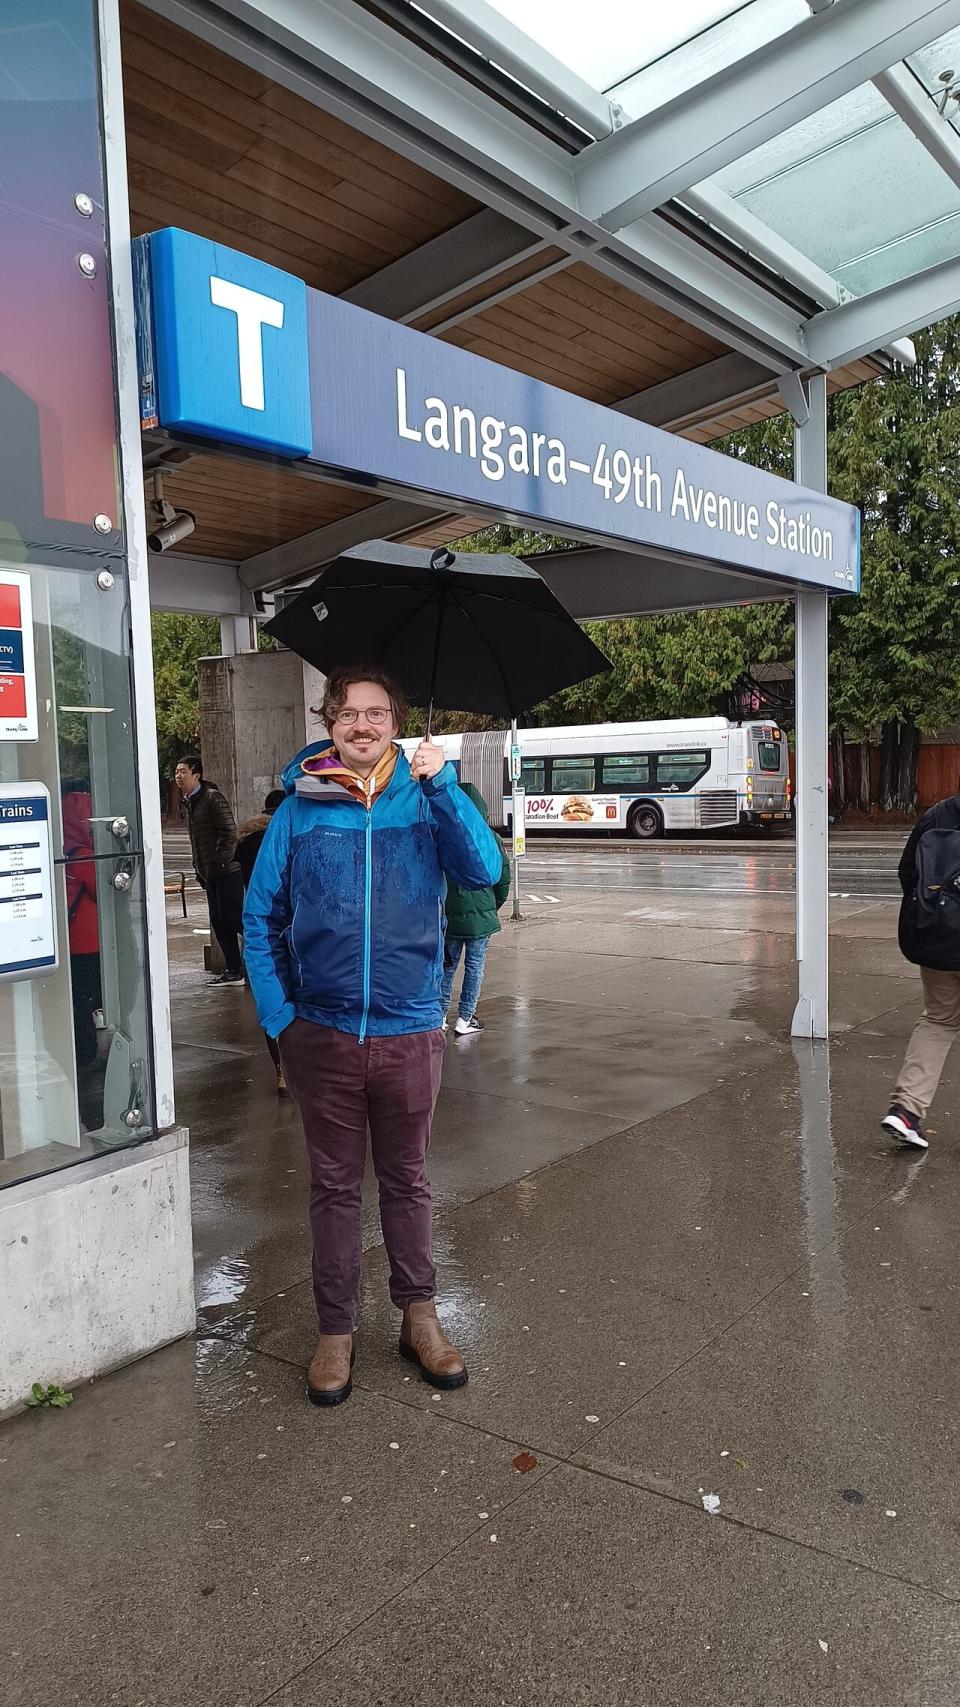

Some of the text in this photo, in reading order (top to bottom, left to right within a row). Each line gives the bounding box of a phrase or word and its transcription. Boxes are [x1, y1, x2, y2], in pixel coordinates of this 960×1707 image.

[209, 275, 285, 411] T
[671, 468, 760, 541] Avenue
[765, 499, 834, 562] Station
[527, 798, 554, 814] 100%
